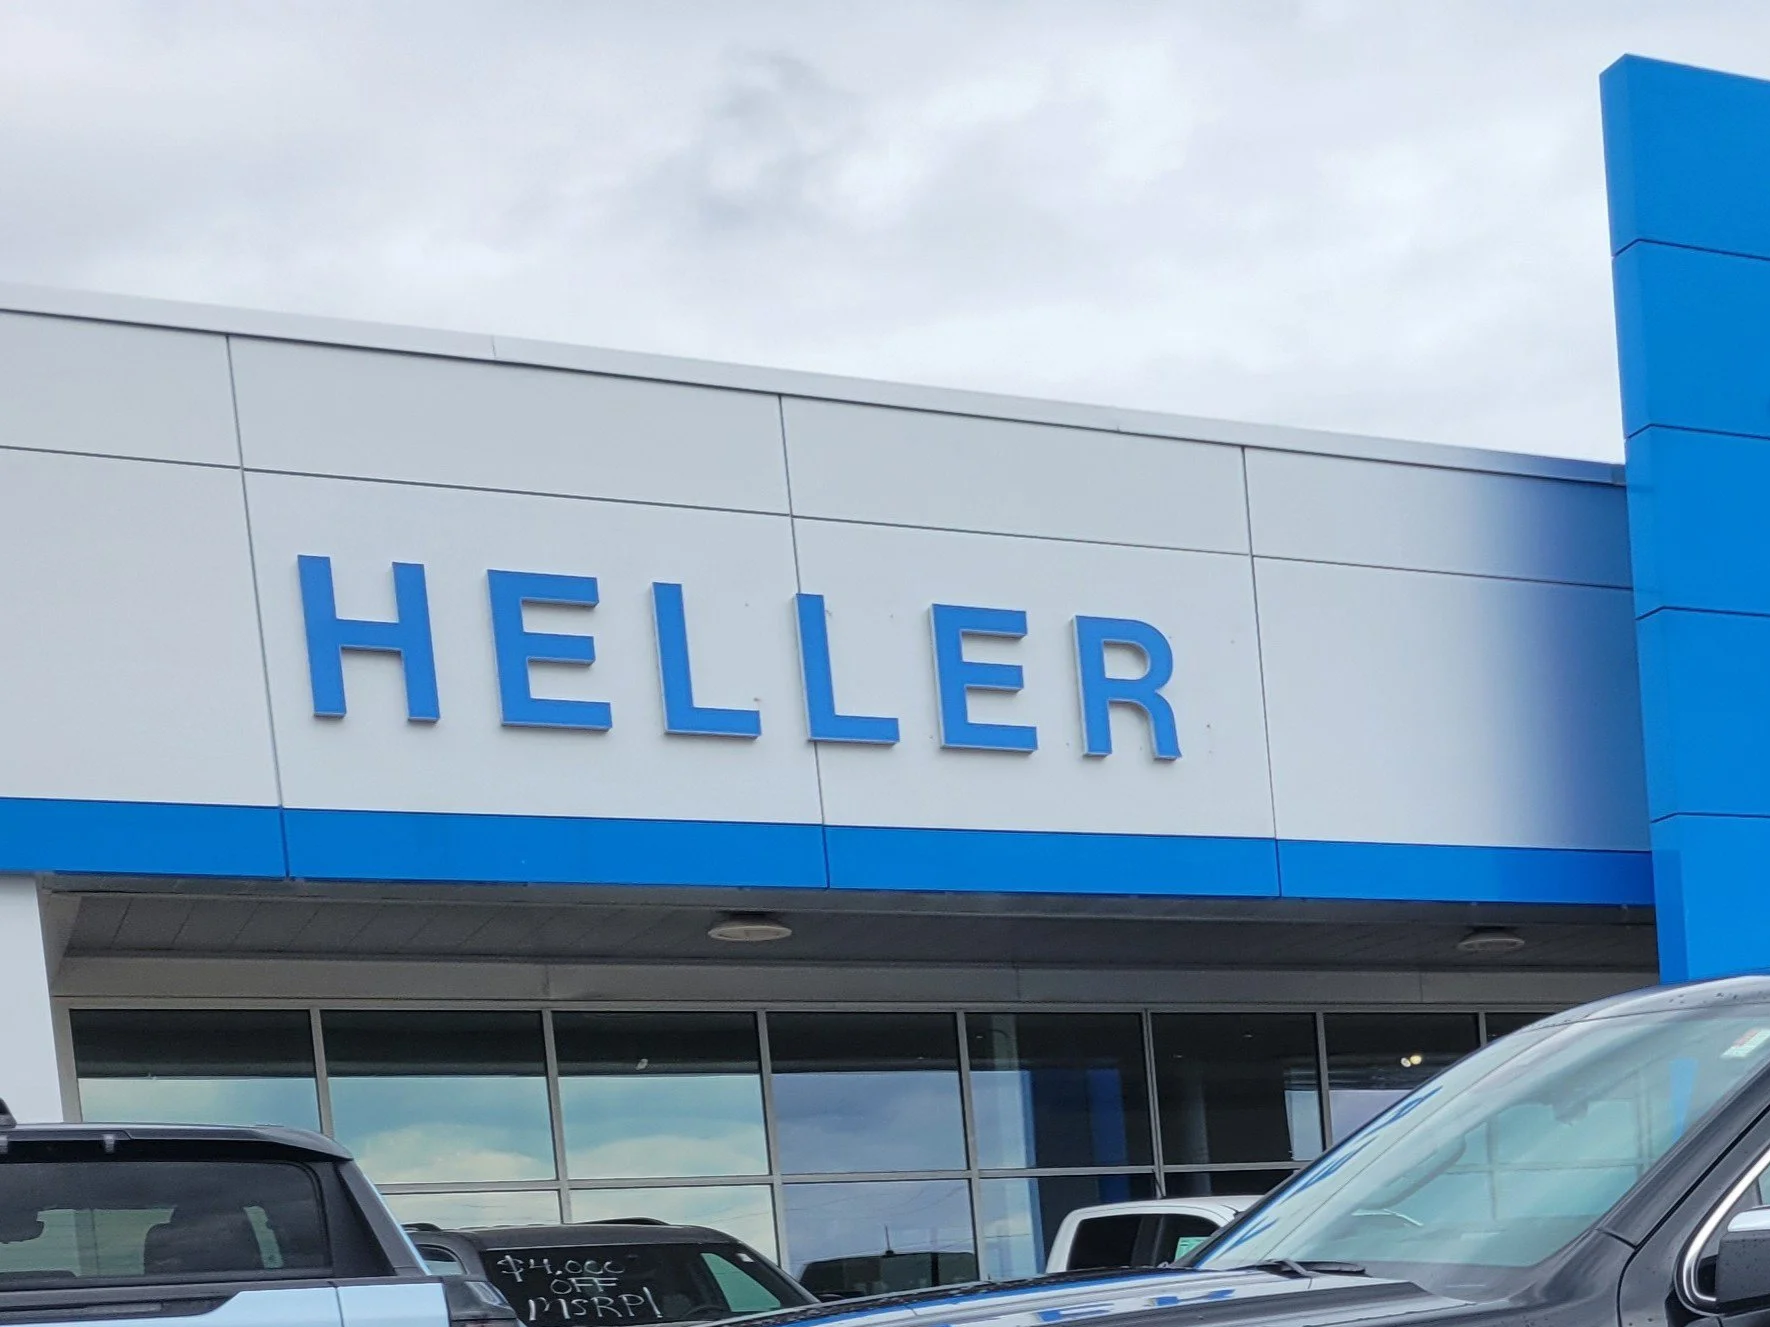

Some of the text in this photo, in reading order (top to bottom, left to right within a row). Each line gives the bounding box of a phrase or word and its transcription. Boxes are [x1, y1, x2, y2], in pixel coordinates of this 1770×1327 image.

[297, 554, 1181, 760] HELLER
[551, 1277, 619, 1294] OFF
[529, 1287, 663, 1321] MSRP!
